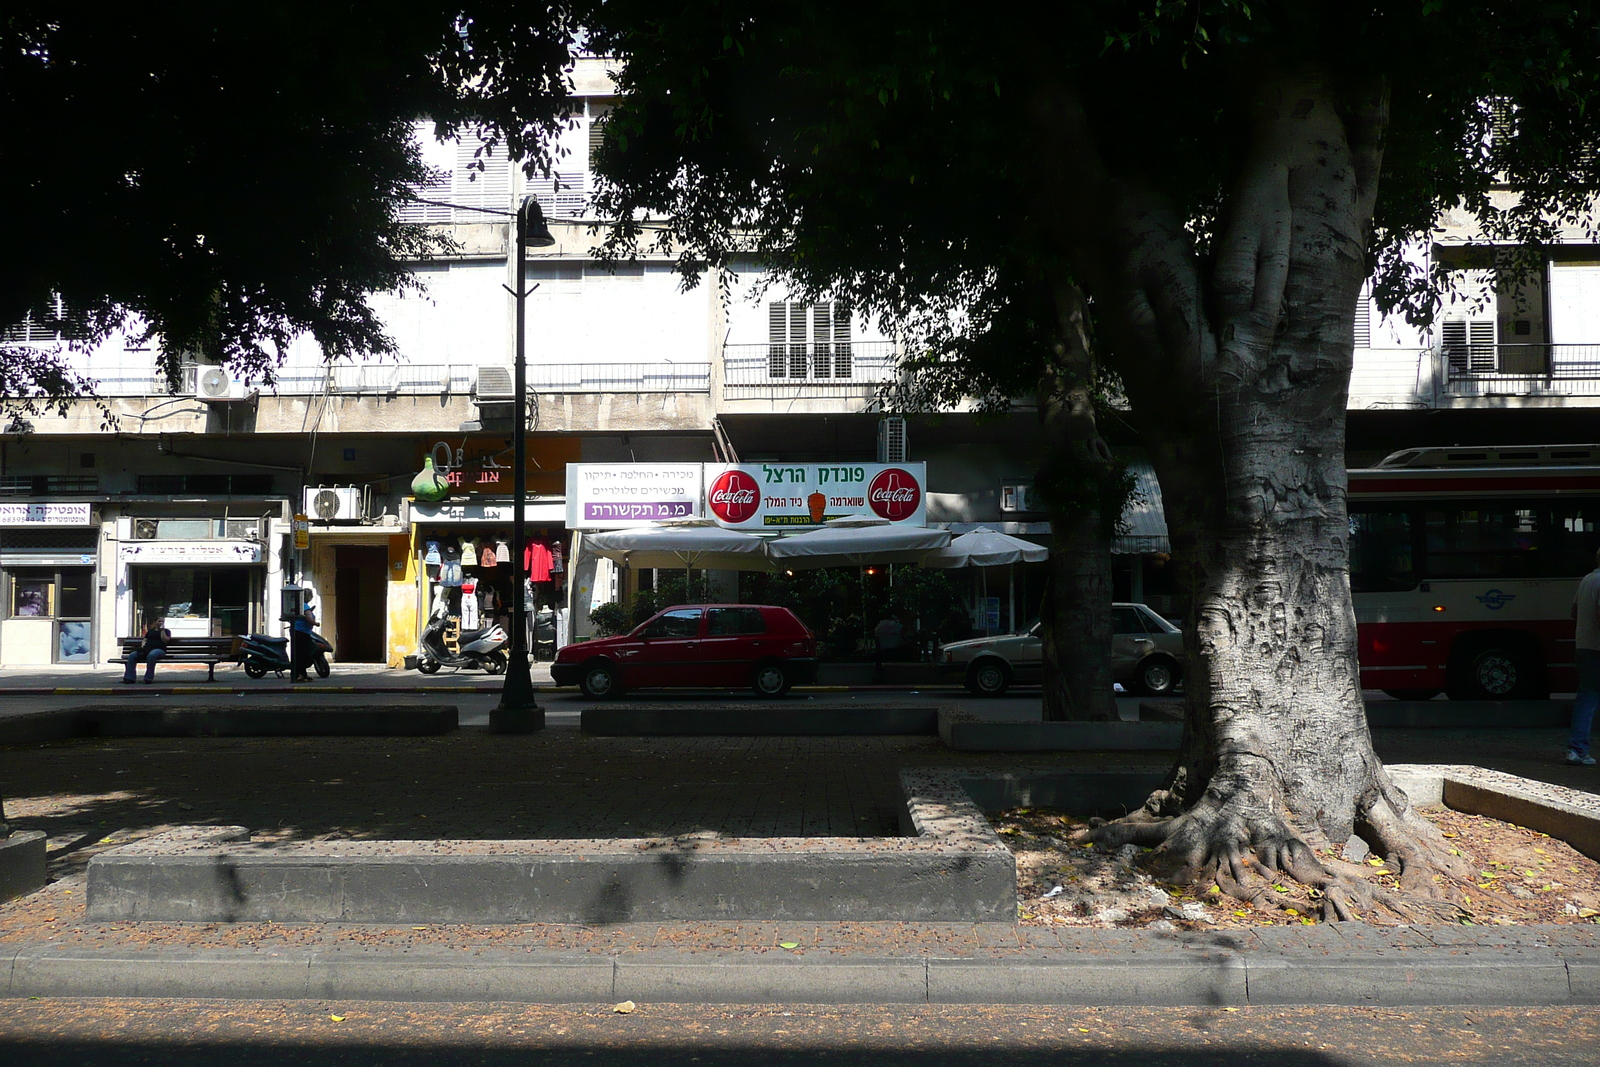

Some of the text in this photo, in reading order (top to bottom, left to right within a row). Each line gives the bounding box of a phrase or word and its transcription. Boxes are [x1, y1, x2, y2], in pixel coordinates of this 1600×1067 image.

[584, 470, 694, 481] מכירה החלפה תיקון
[763, 464, 865, 485] פונדק הרצל
[592, 485, 685, 495] מכשירים סלולריים
[763, 495, 865, 509] שווארמה כיד המלך
[35, 506, 87, 515] אופטיקה
[591, 504, 686, 518] מ.מ תקשורת
[790, 516, 811, 524] הרבנות
[191, 545, 223, 554] אטליז
